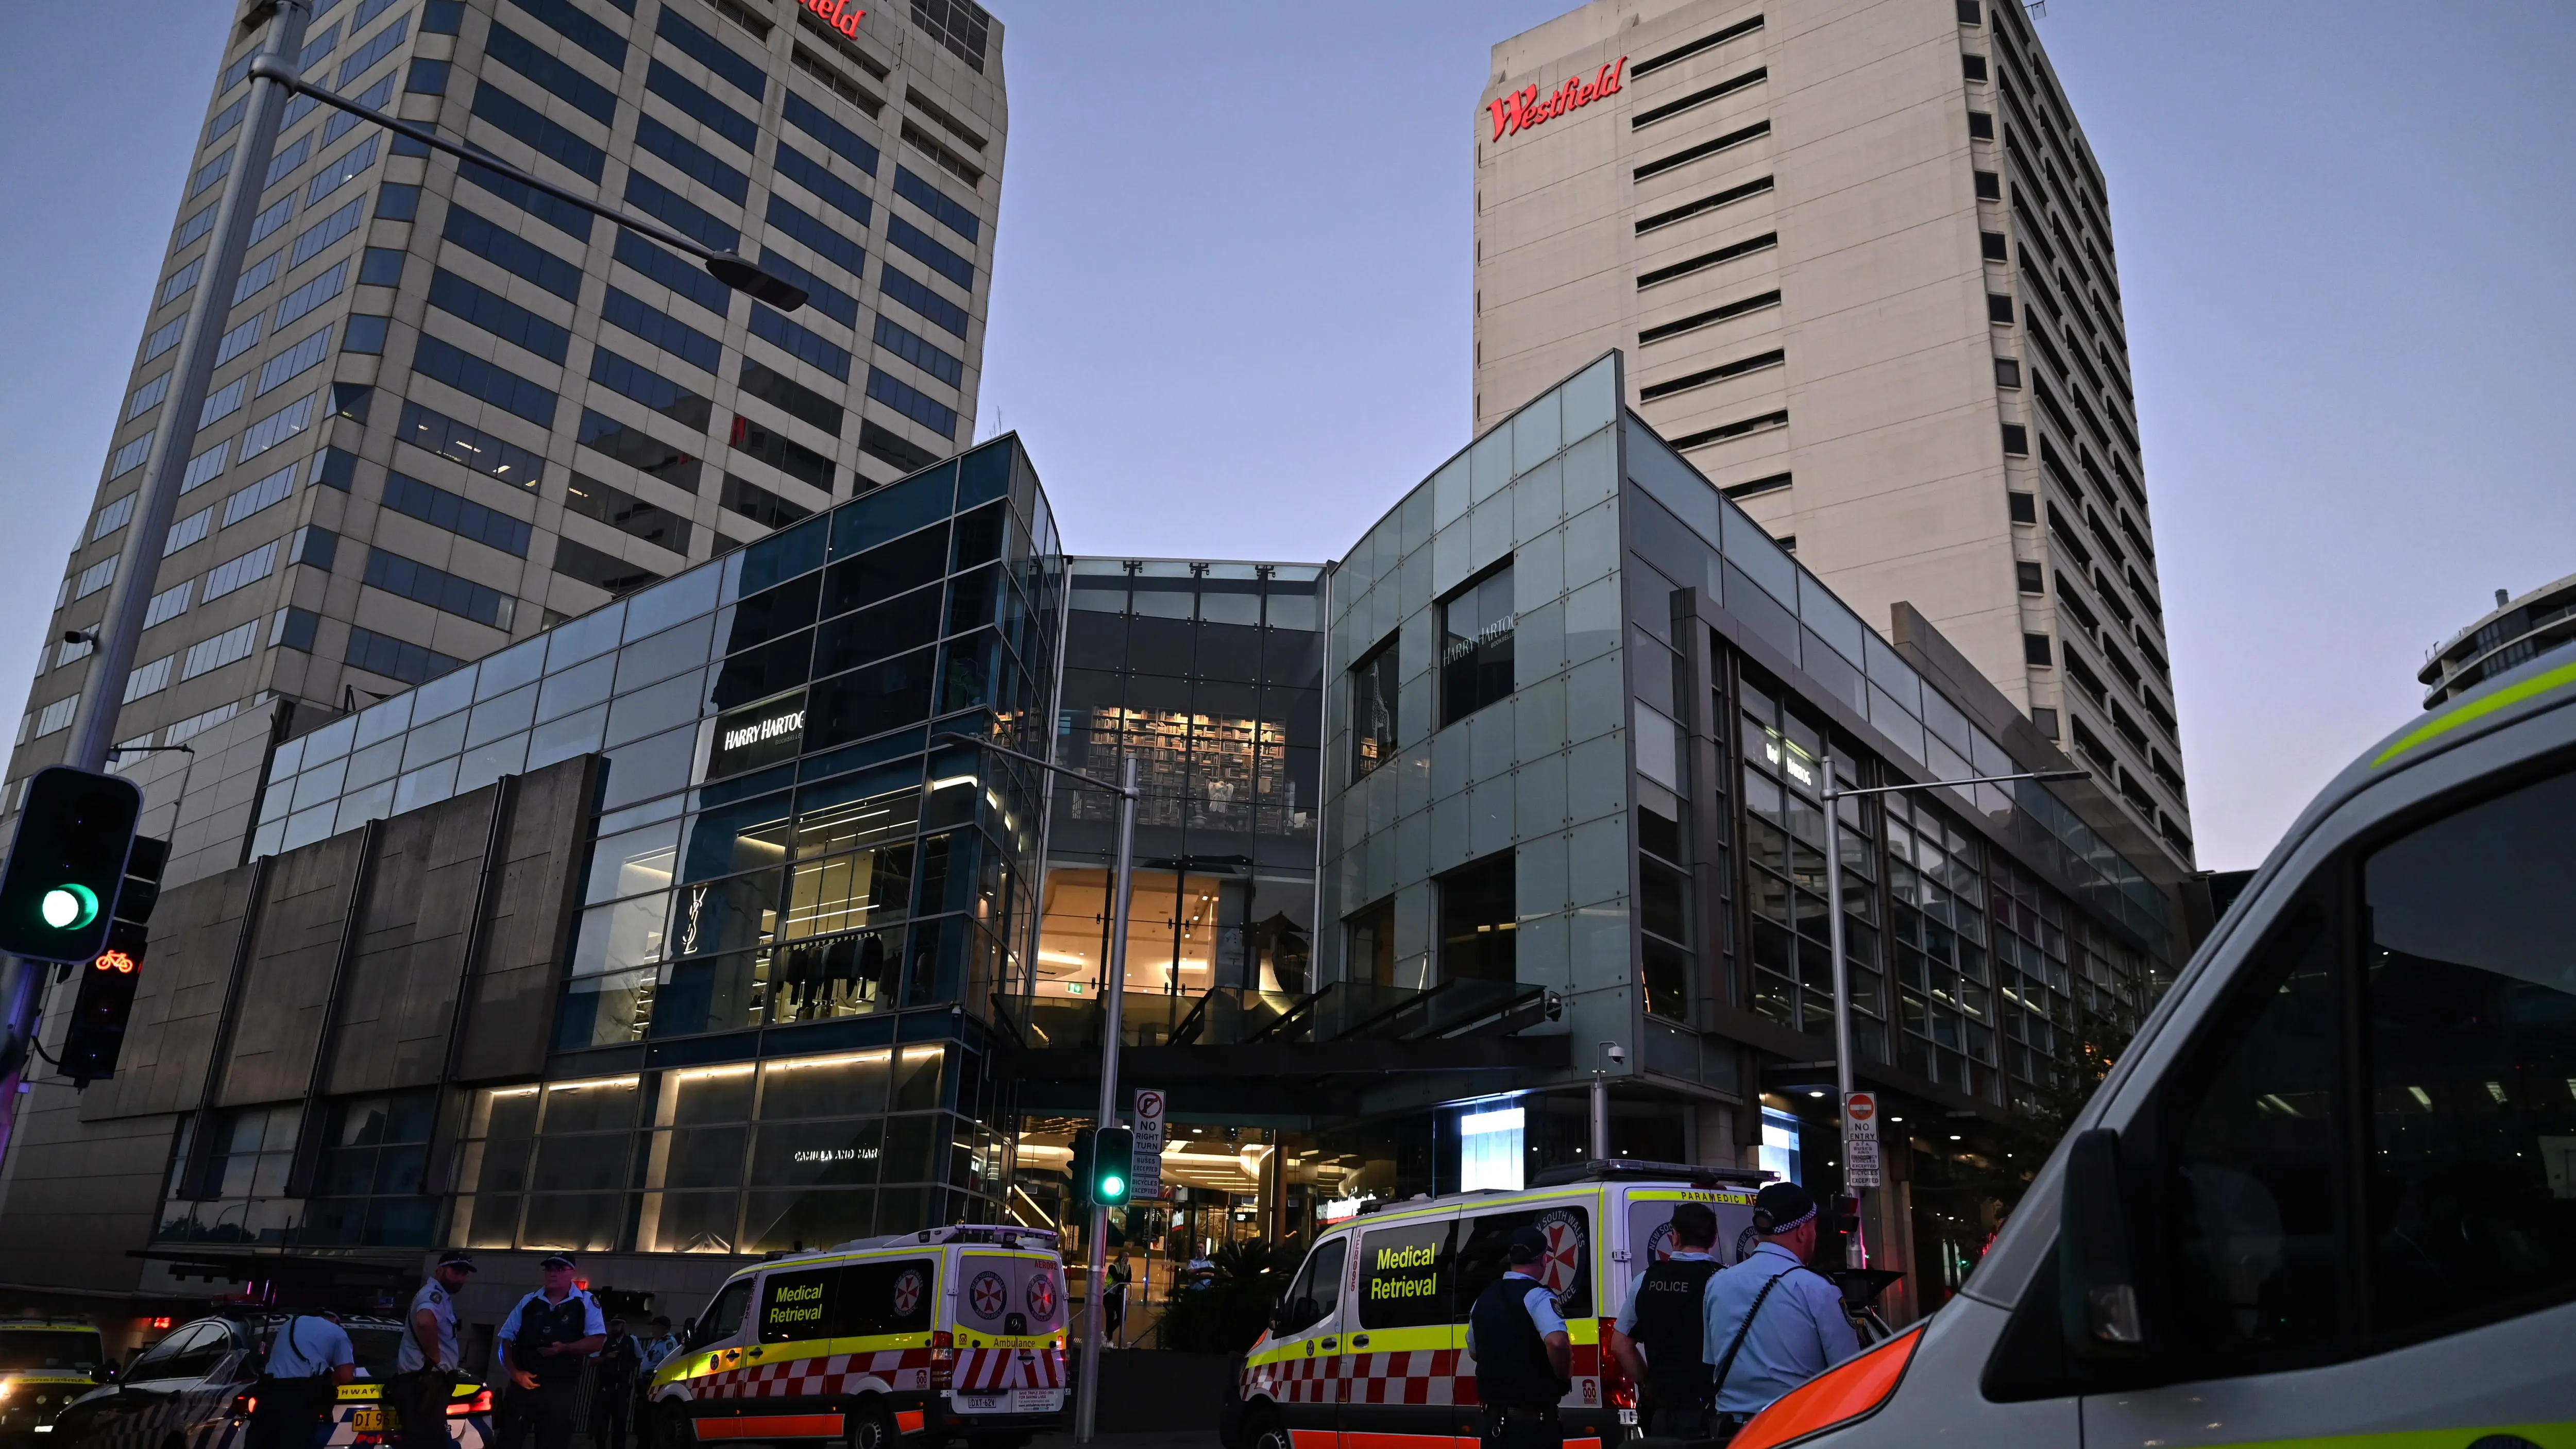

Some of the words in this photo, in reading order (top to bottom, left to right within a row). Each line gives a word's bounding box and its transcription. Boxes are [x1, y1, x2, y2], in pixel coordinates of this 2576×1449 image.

[1486, 56, 1628, 143] Westfield
[1443, 635, 1475, 667] HARRY
[724, 724, 761, 751] HARRY
[1140, 1121, 1156, 1131] NO
[794, 1150, 832, 1161] CAMILLA
[835, 1149, 854, 1160] AND
[1682, 1191, 1739, 1203] PARAMEDIC
[1543, 1211, 1567, 1223] SOUTH
[1568, 1214, 1585, 1248] WALES
[1649, 1230, 1661, 1251] NEW
[1737, 1231, 1747, 1252] NEW
[1035, 1260, 1057, 1270] AER092
[1377, 1242, 1435, 1270] Medical
[776, 1283, 823, 1302] Medical
[971, 1277, 980, 1289] NEW
[995, 1274, 1005, 1292] WALES
[1371, 1272, 1436, 1300] Retrieval
[1649, 1281, 1689, 1292] POLICE
[770, 1303, 822, 1323] Retrieval
[975, 1308, 1003, 1320] AMBULANCE
[994, 1338, 1035, 1348] Ambulance
[1583, 1387, 1596, 1397] 000
